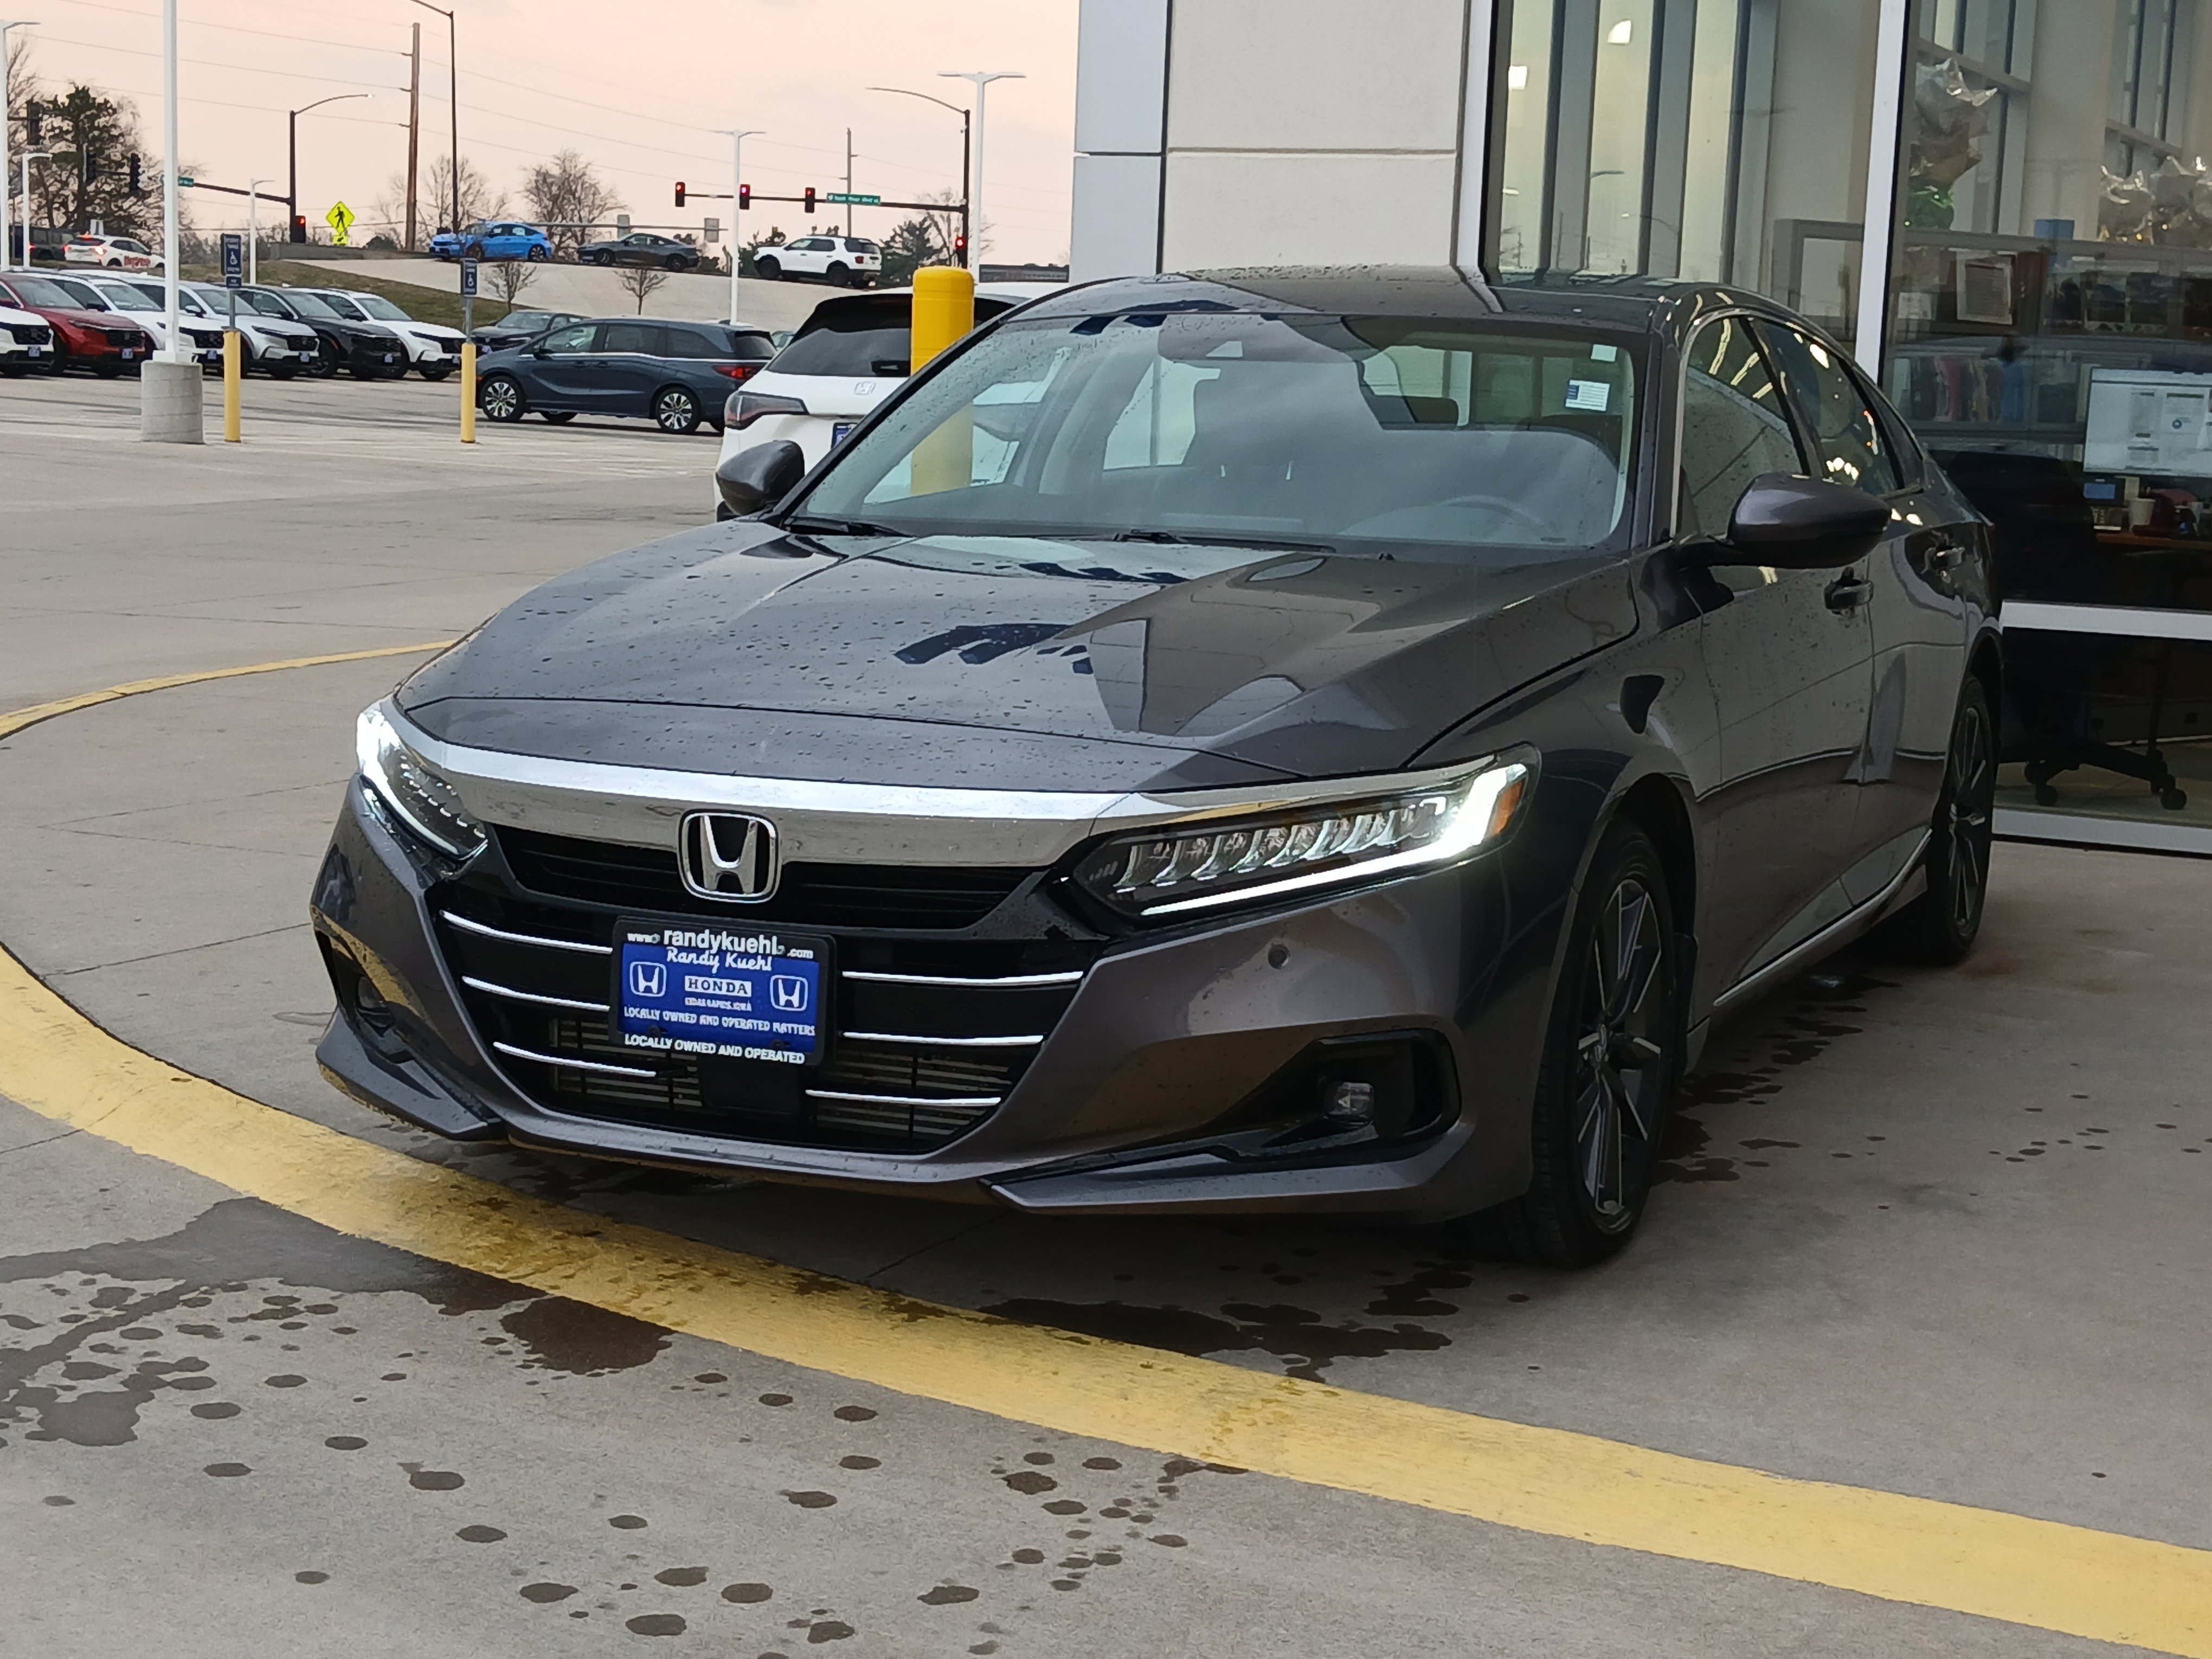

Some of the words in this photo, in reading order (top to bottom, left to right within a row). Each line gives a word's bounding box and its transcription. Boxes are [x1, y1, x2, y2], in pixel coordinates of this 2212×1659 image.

[664, 929, 777, 955] randykuehl
[666, 947, 720, 974] Randy
[725, 952, 772, 971] Kuehl
[688, 978, 748, 994] HONDA
[624, 1006, 660, 1020] LOCALLY
[663, 1011, 697, 1024] OWNED
[699, 1015, 719, 1026] AND
[722, 1017, 770, 1031] OPERATED
[625, 1033, 673, 1049] LOCALLY
[674, 1039, 716, 1054] OWNED
[718, 1045, 742, 1057] AND
[744, 1047, 805, 1064] OPERATED
